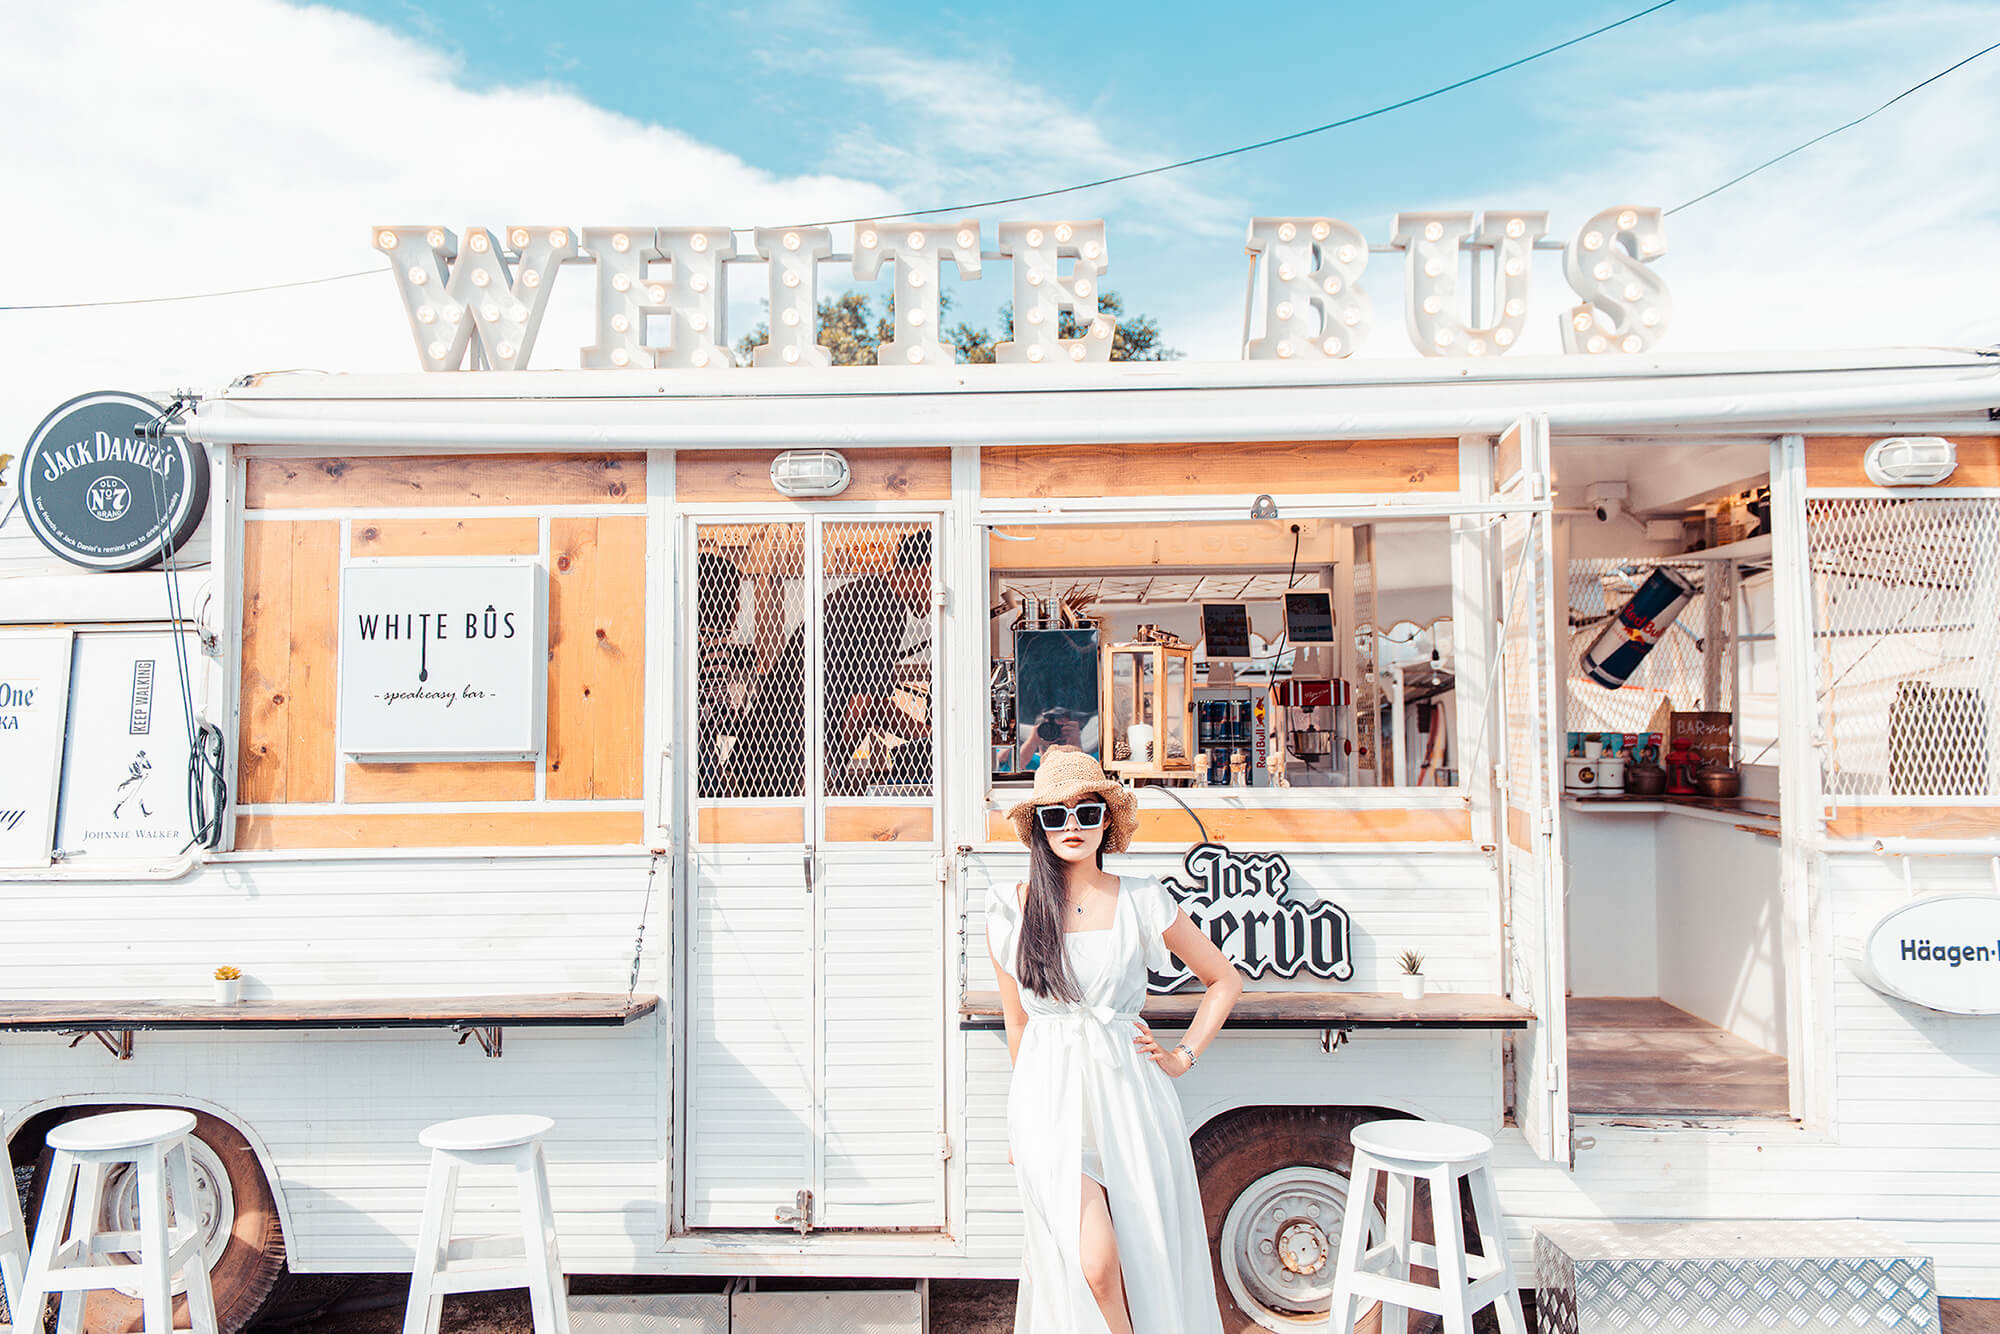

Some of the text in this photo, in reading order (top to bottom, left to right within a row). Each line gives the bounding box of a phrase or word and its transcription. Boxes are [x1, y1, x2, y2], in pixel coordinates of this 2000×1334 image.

[371, 205, 1673, 371] WHITE BUS
[41, 440, 94, 481] JACK
[100, 480, 117, 488] OLD
[133, 663, 151, 732] KEEP WALKING
[384, 684, 486, 708] speakeasy bar
[83, 829, 180, 842] JOHNNIE WALKER
[1192, 851, 1283, 908] Jose
